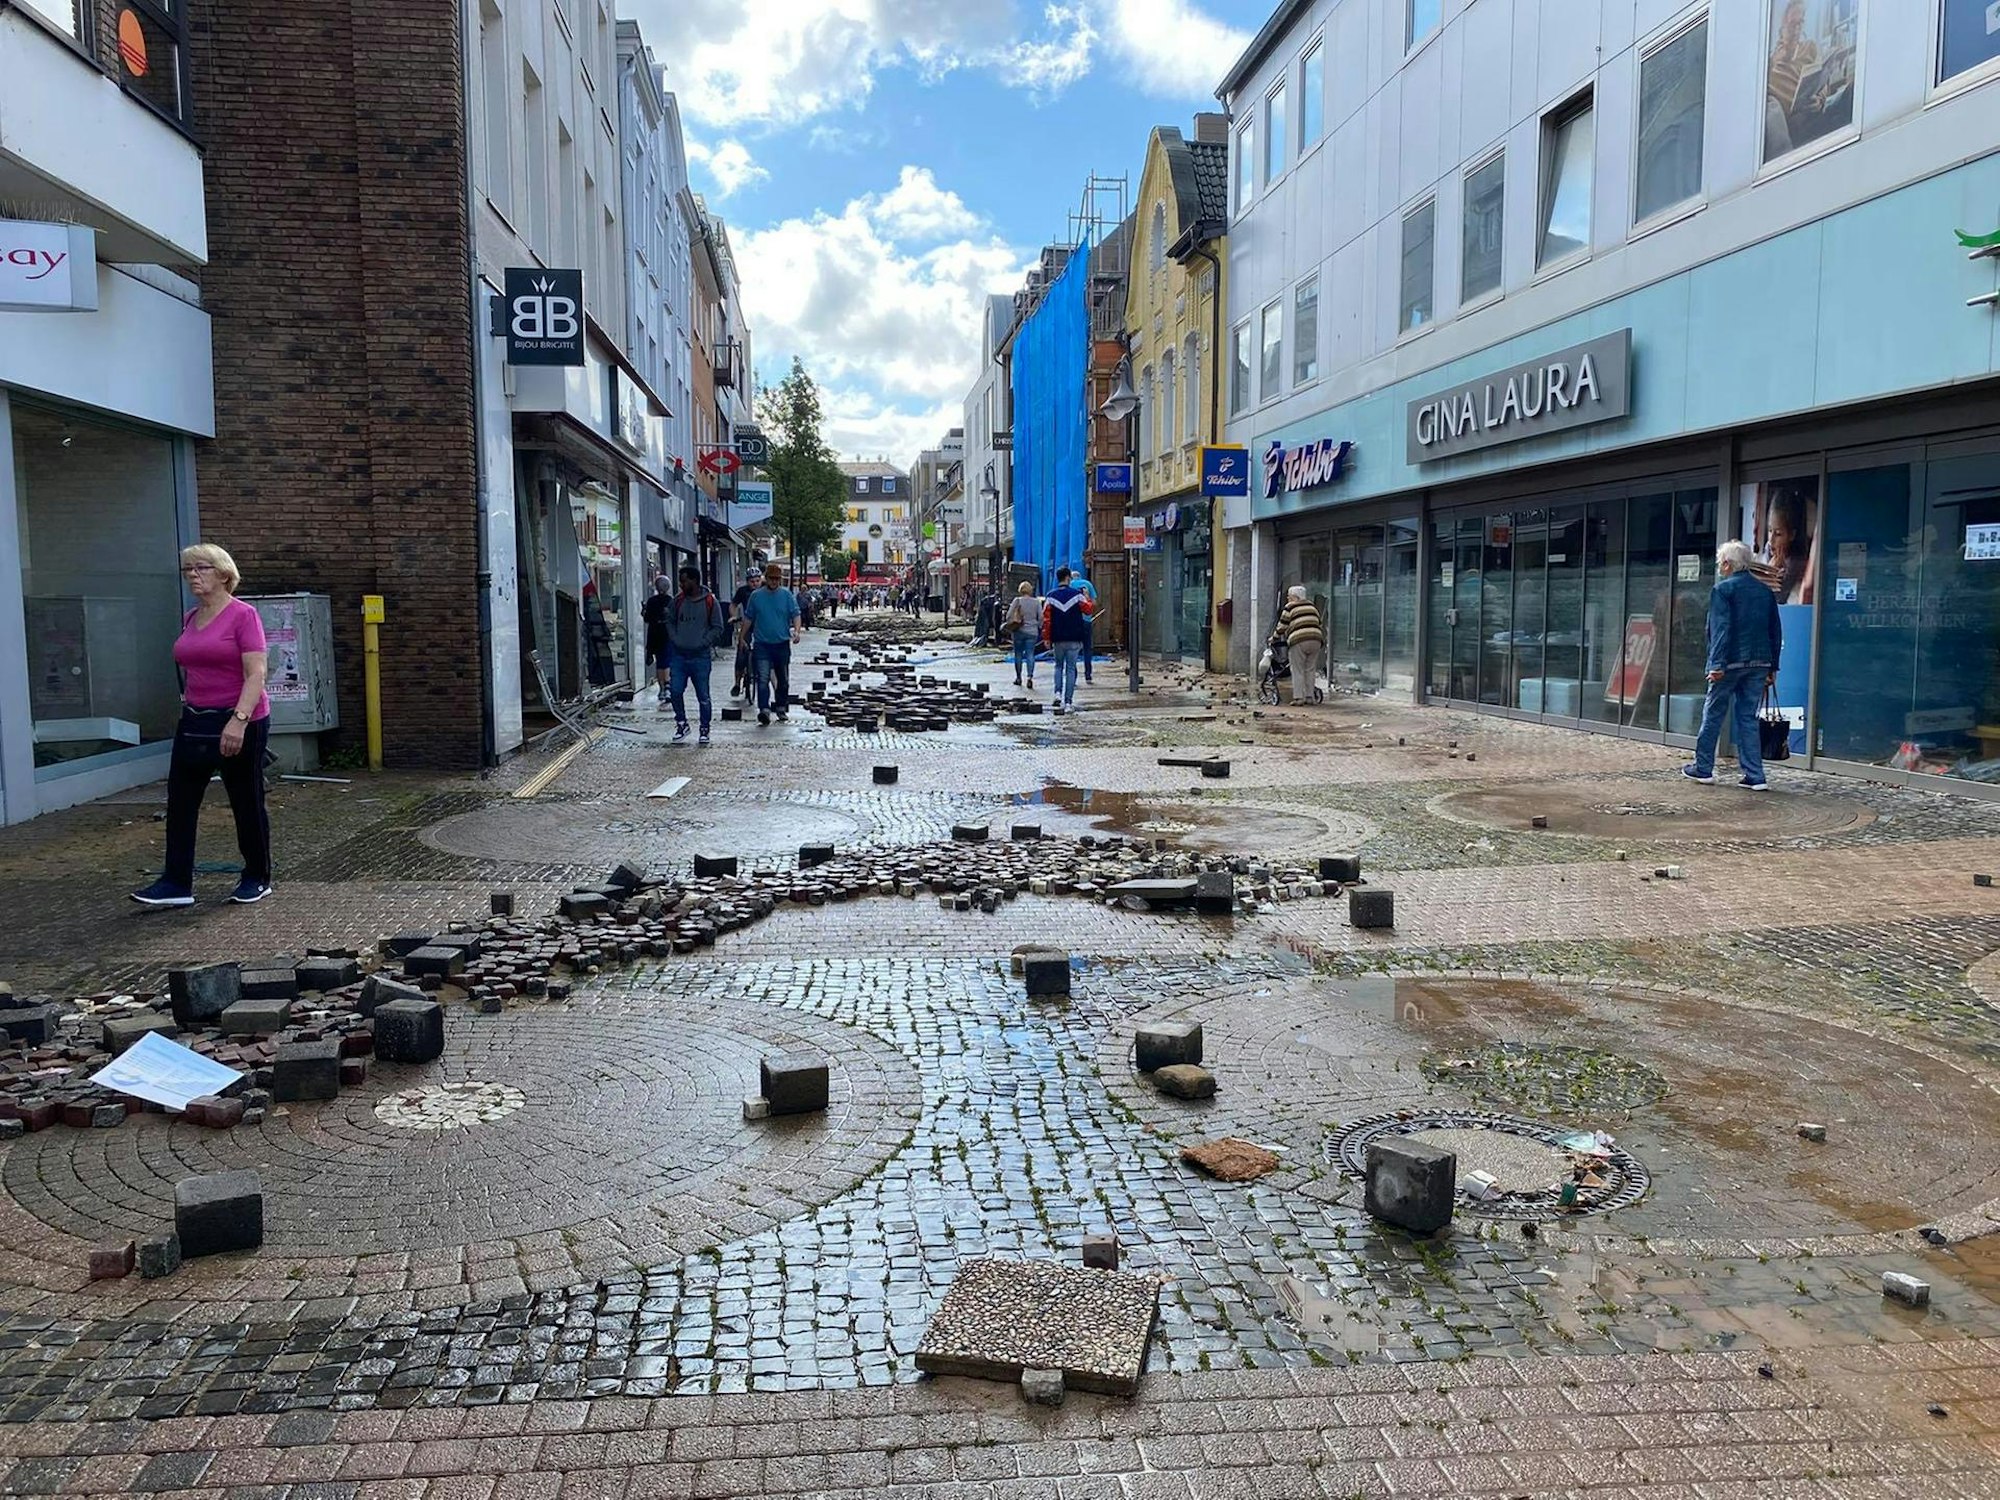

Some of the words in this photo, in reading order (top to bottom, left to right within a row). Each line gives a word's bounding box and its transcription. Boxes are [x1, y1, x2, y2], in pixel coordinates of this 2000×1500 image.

[512, 295, 578, 338] BB
[514, 340, 538, 349] BIJOU
[540, 341, 575, 349] BRIGITTE
[1416, 390, 1479, 446] GINA
[1483, 352, 1601, 428] LAURA
[1282, 439, 1343, 492] Tchibo
[1102, 480, 1126, 489] Apollo
[1206, 474, 1244, 486] Tchibo
